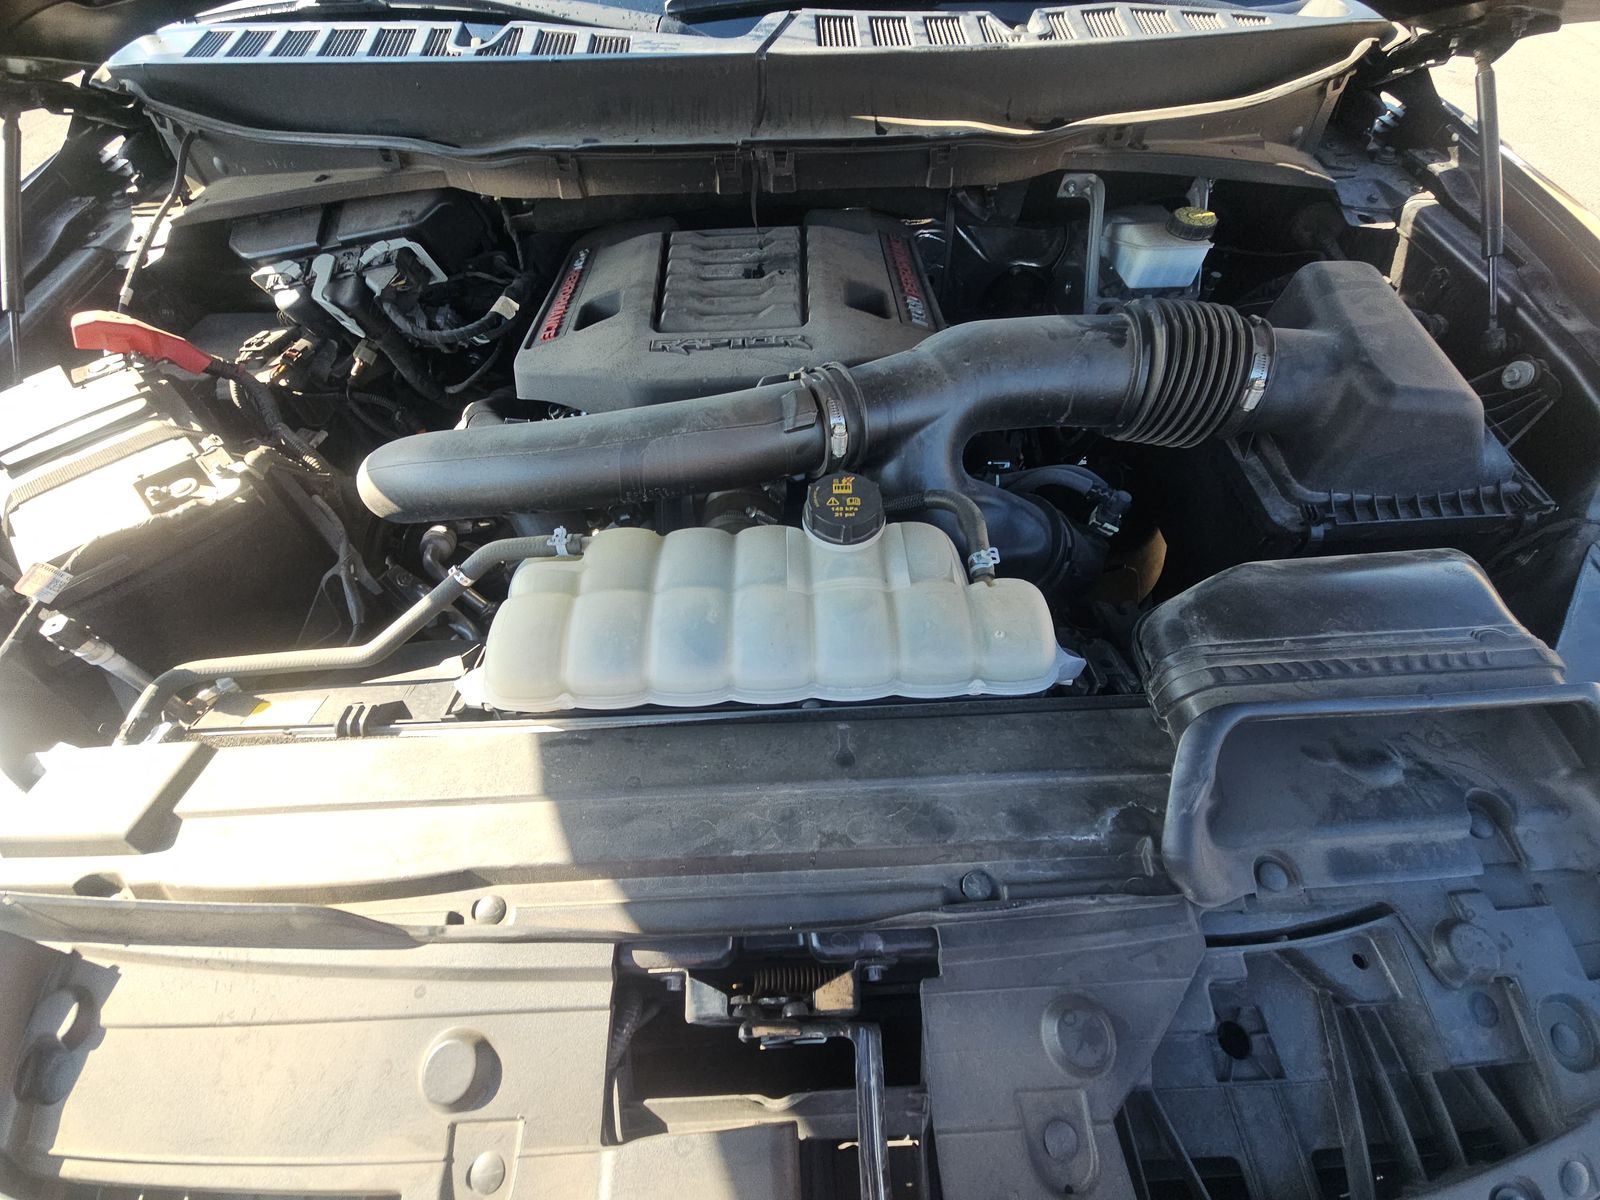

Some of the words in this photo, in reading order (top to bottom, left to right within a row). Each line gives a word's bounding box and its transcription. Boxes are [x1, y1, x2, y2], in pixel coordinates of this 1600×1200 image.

[540, 268, 583, 342] PERFORMANCE
[906, 295, 929, 328] FORD
[649, 335, 813, 355] RAPTOR
